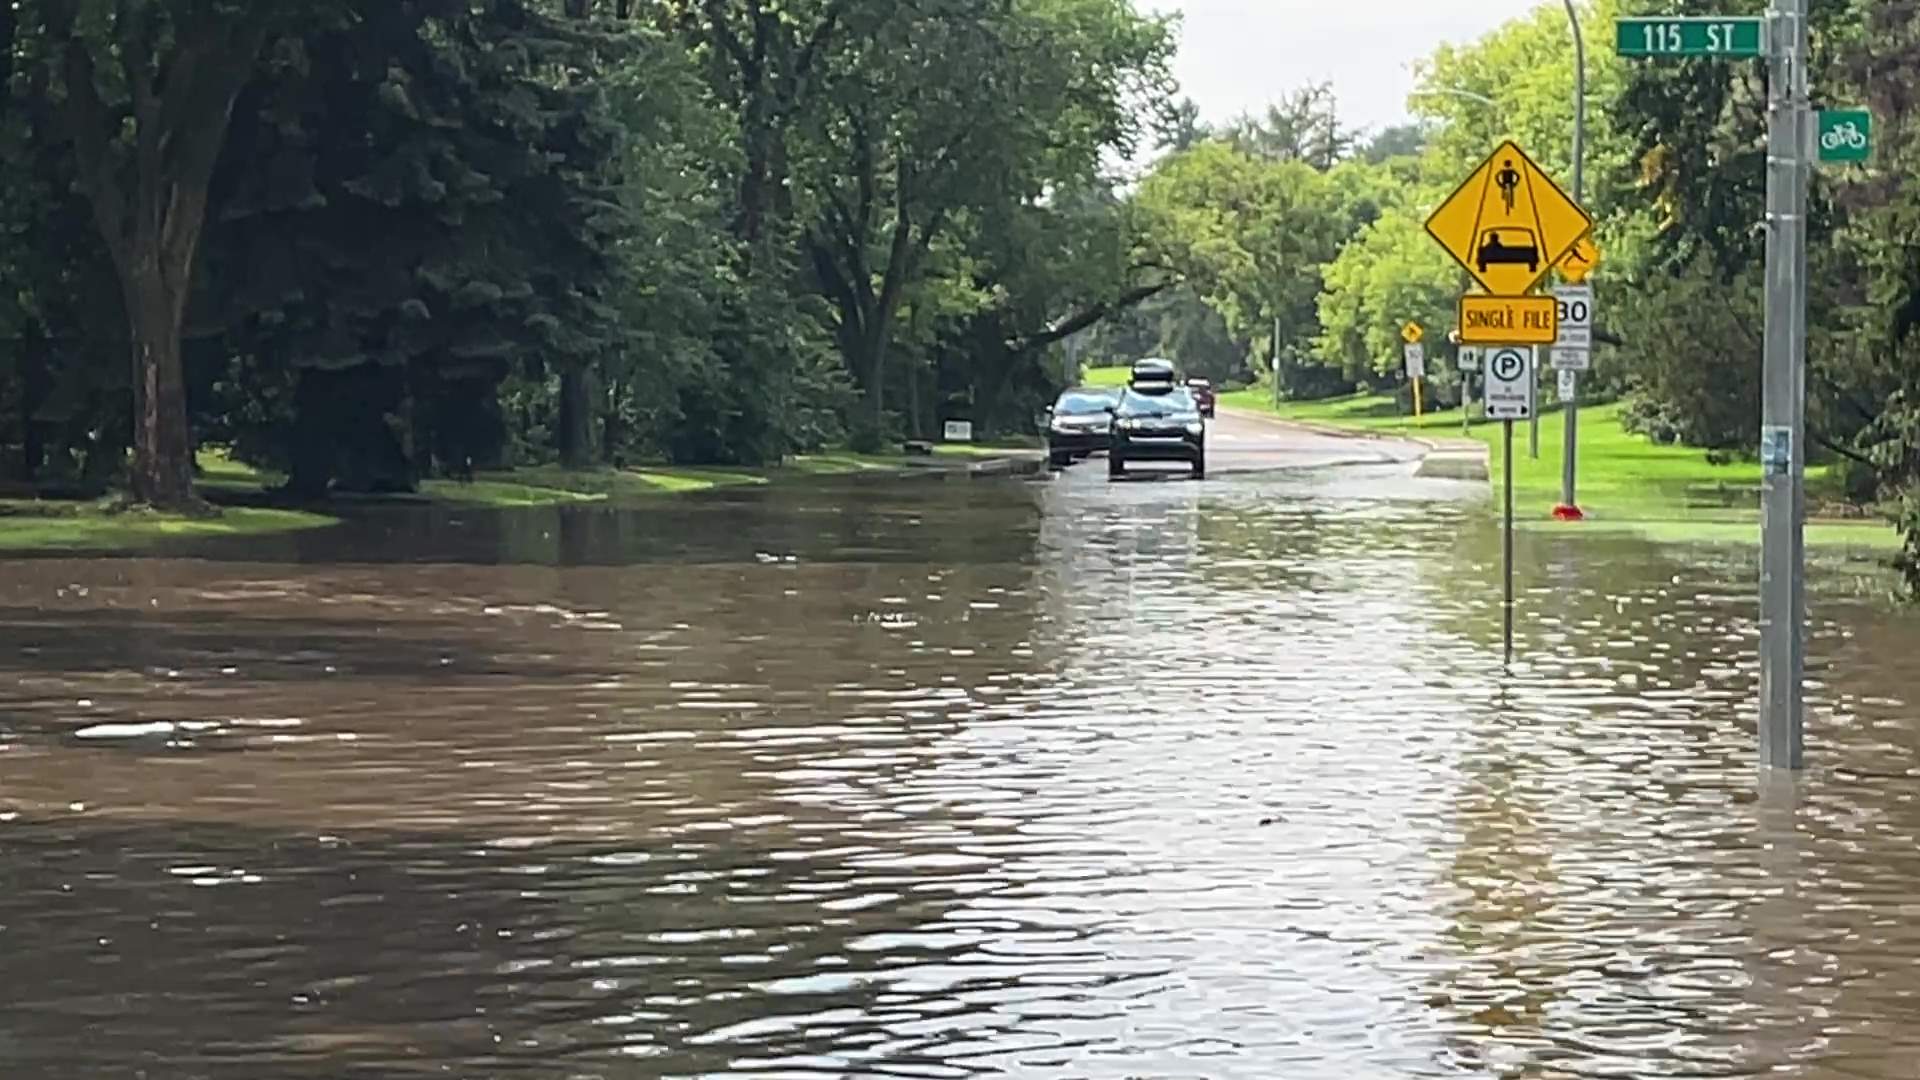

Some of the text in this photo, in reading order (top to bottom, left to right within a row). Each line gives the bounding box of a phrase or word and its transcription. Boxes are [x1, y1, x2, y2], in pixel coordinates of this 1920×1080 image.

[1643, 23, 1735, 51] 115 ST
[1466, 309, 1550, 329] SINGLE FILE
[1557, 301, 1587, 322] 30
[1502, 357, 1516, 375] P
